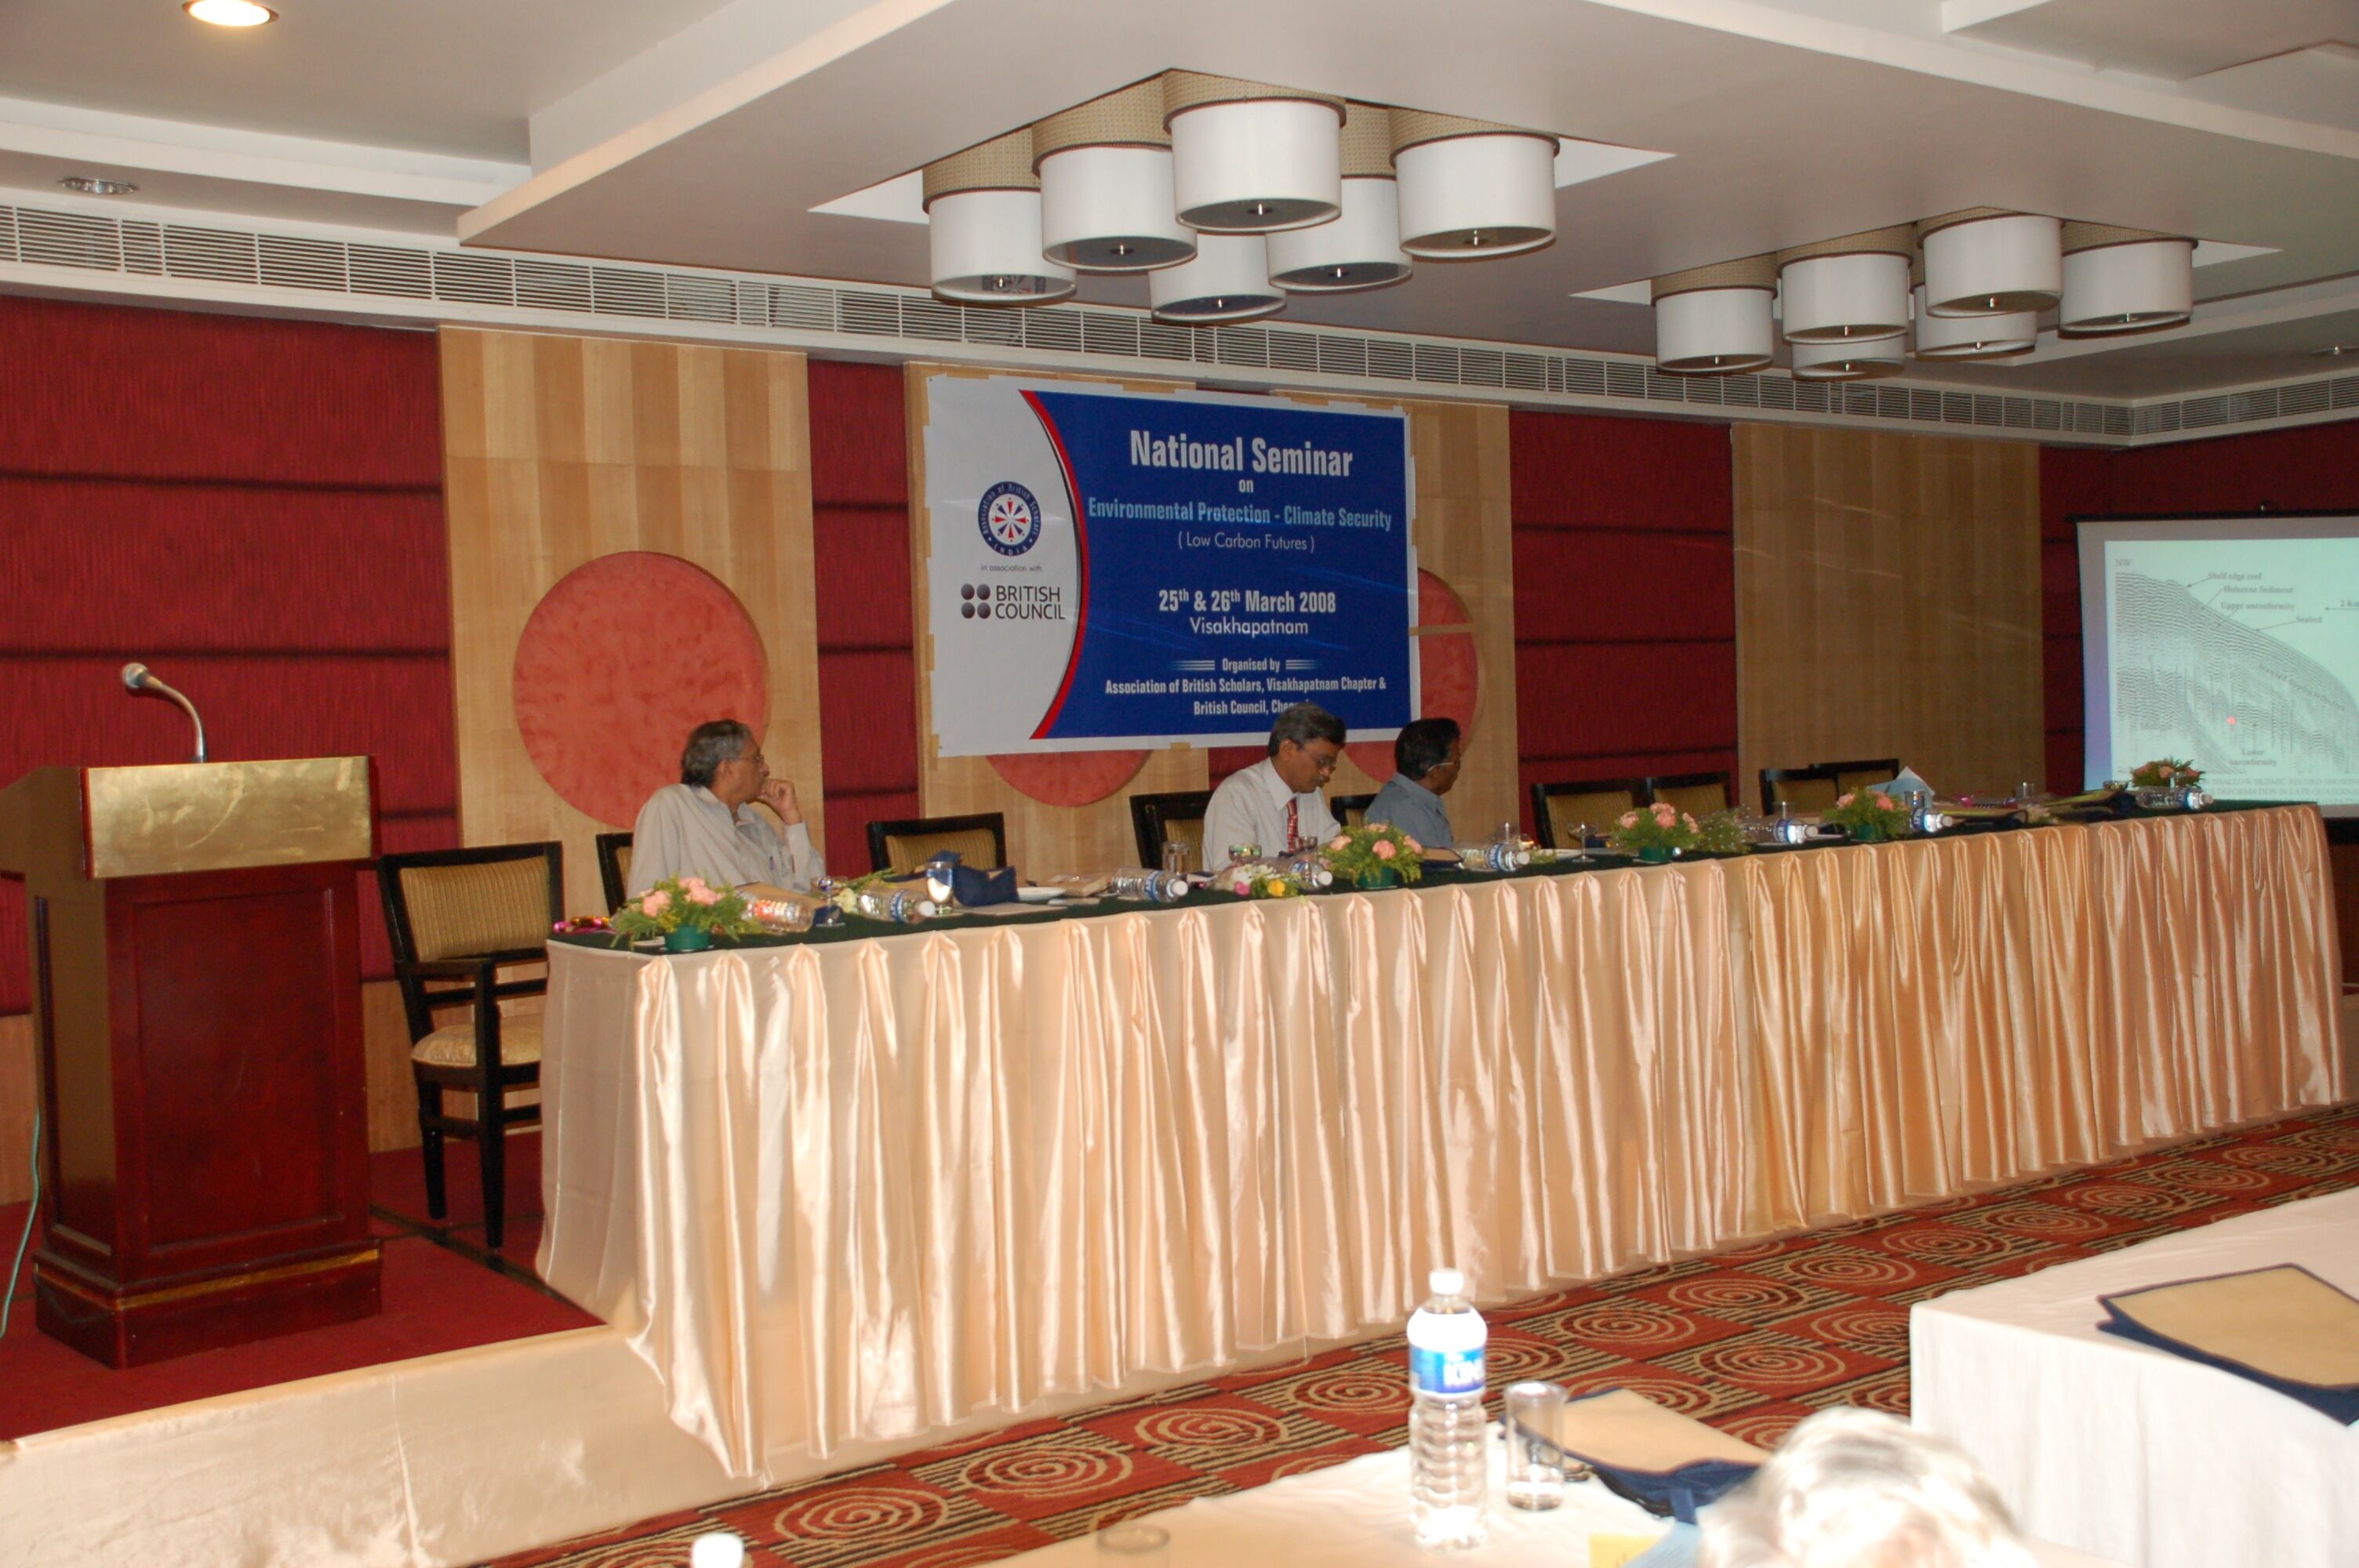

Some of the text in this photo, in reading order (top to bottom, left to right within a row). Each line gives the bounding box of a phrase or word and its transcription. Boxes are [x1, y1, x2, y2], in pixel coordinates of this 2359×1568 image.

[1130, 430, 1354, 477] National Seminar
[1238, 479, 1254, 493] on
[1088, 496, 1194, 521] Environmental
[1198, 502, 1270, 524] Protection
[1284, 506, 1335, 526] Climate
[1338, 508, 1392, 532] Security
[1187, 532, 1211, 547] Low
[1214, 532, 1261, 549] Carbon
[1264, 533, 1307, 550] Futures
[989, 564, 1027, 572] association
[996, 585, 1060, 603] BRITISH
[1158, 588, 1336, 613] 25th & 26th March 2008
[995, 603, 1066, 620] COUNCIL
[1189, 616, 1309, 638] Visakhapatnam
[1222, 658, 1281, 673] Organised by
[1105, 677, 1387, 695] Association of British Scholars, Visakhapatnam Chapter &
[1193, 700, 1228, 715] British
[1230, 699, 1269, 715] Council,
